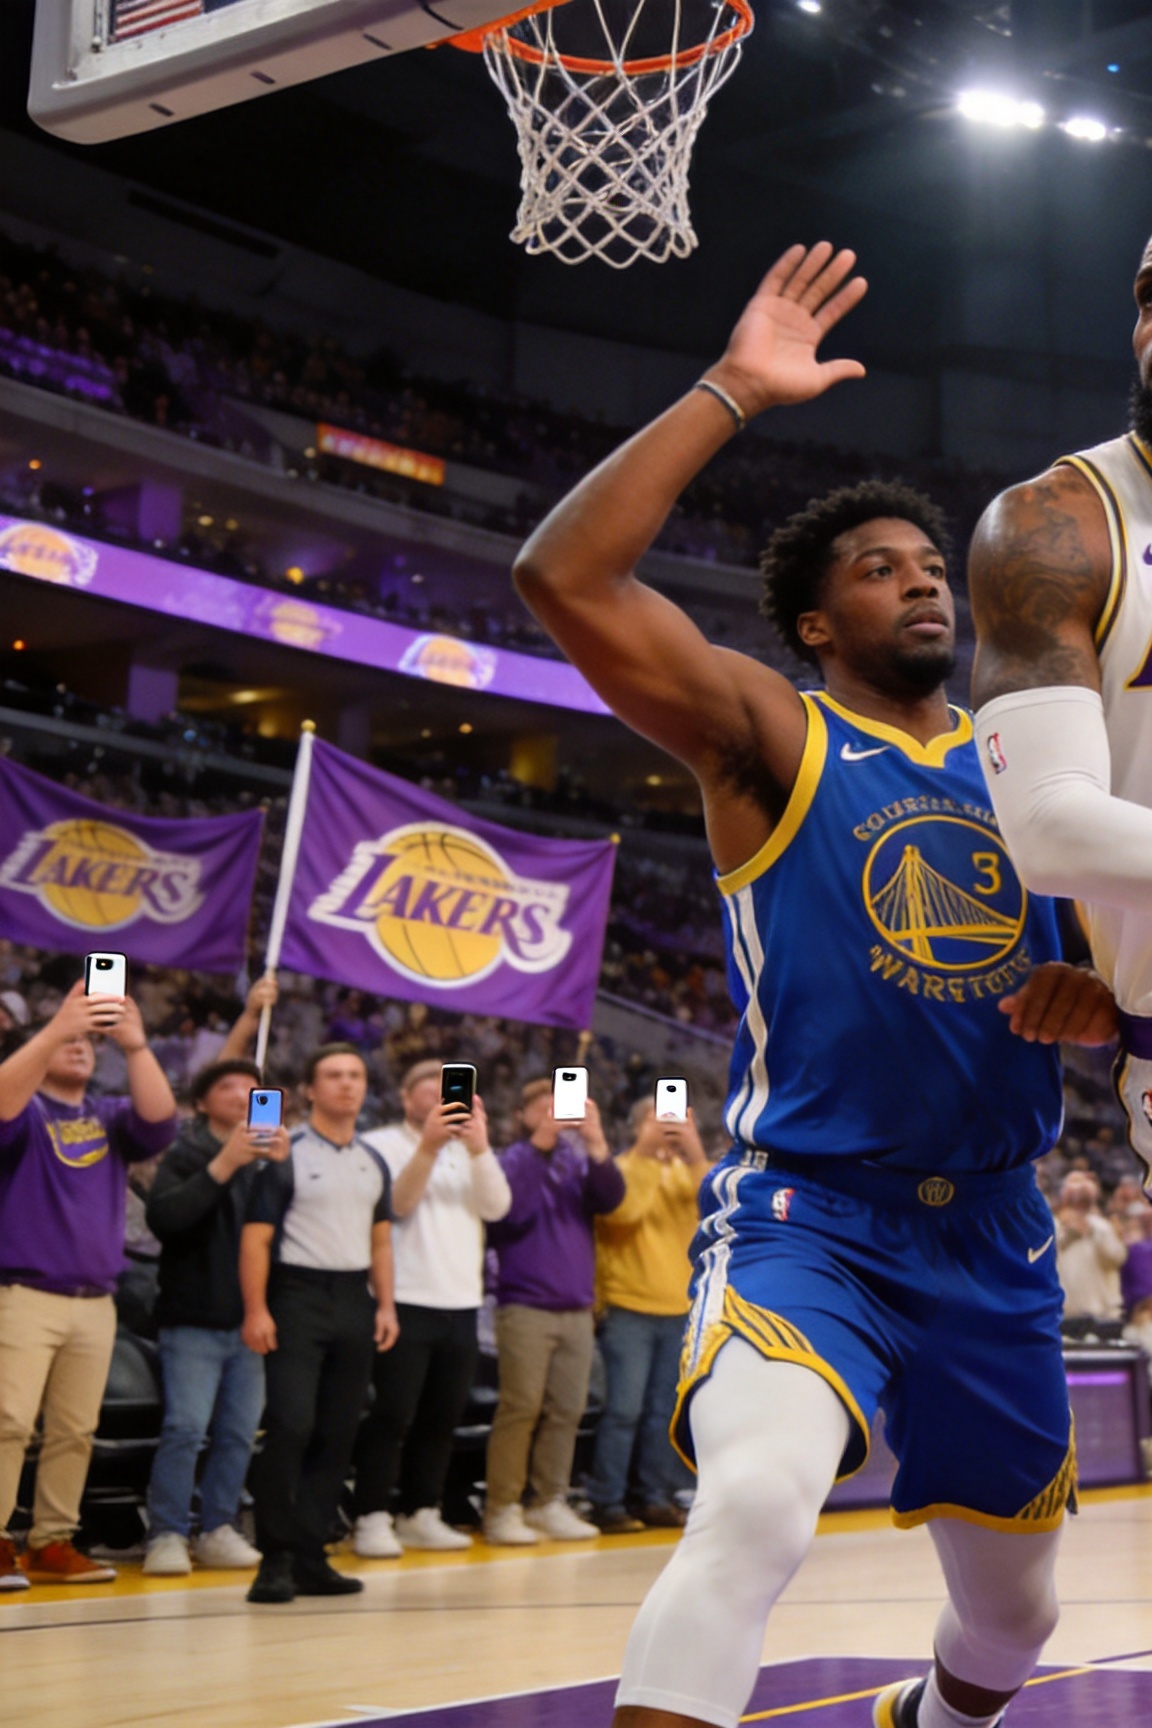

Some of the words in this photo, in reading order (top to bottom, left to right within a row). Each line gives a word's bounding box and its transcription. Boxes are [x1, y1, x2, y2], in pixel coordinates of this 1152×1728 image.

[10, 838, 190, 917] LAKERS
[329, 853, 552, 963] LAKERS
[971, 851, 1002, 895] 3
